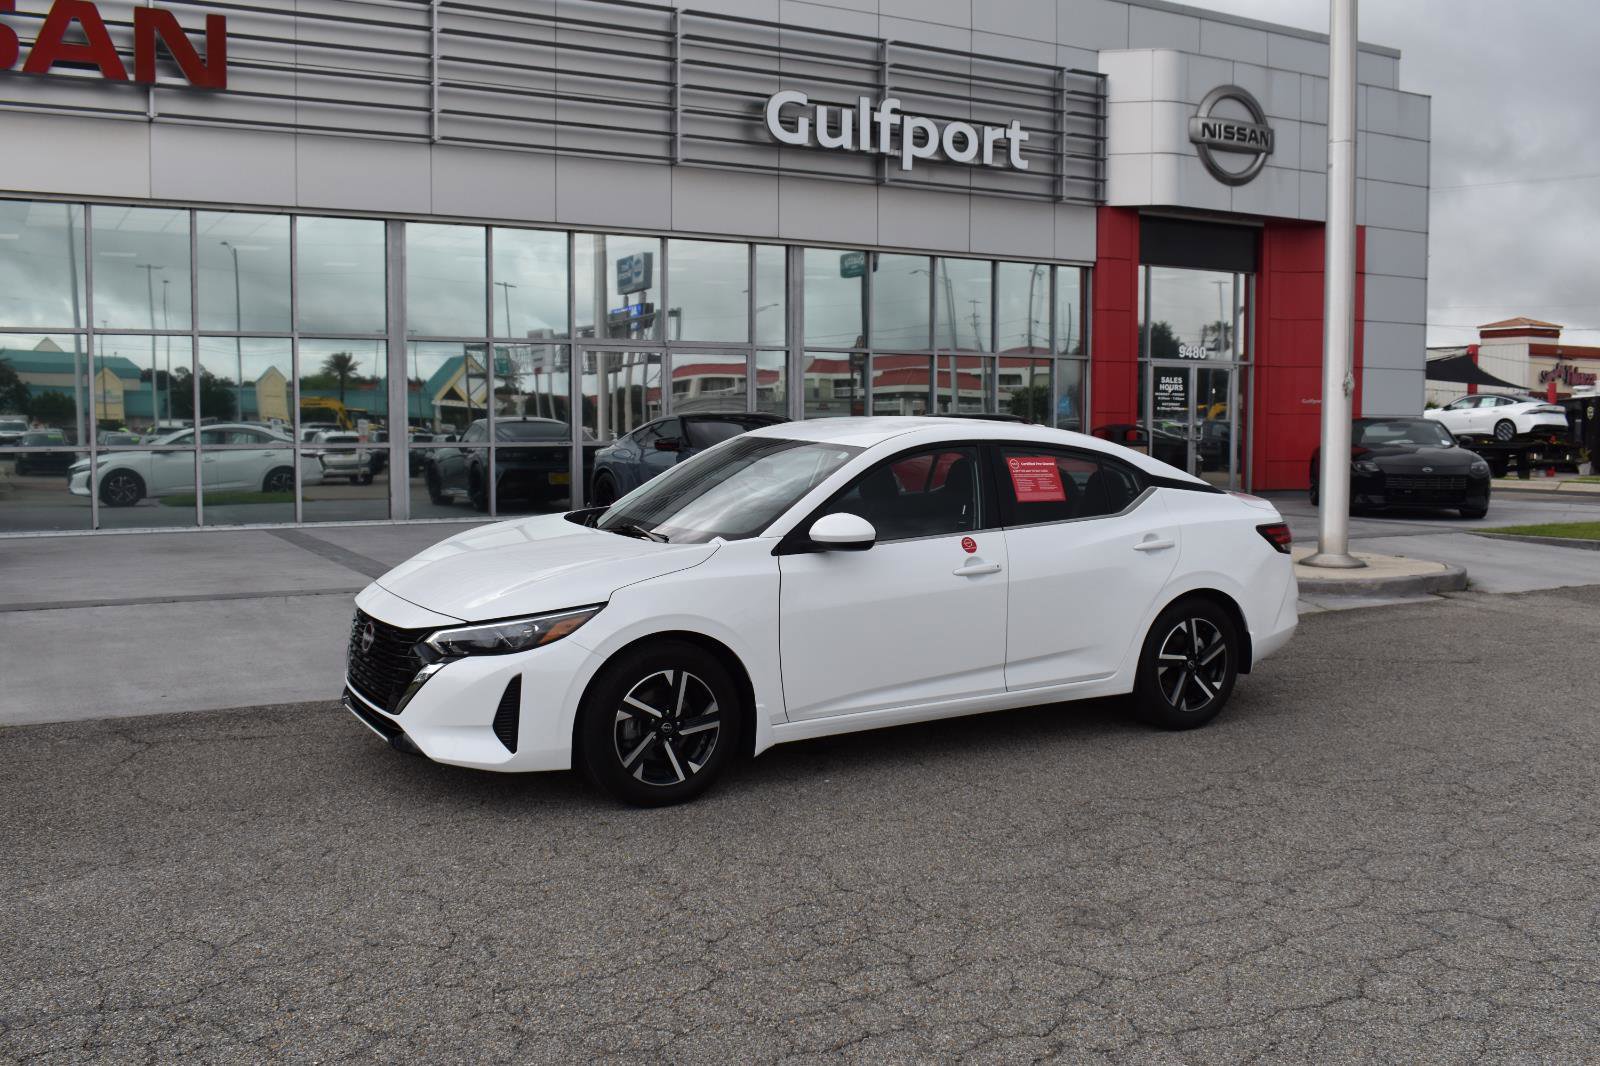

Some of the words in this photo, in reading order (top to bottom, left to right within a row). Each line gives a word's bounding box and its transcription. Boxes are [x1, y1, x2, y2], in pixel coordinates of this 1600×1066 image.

[0, 0, 227, 89] AN
[764, 89, 1030, 171] Gulfport
[1201, 121, 1271, 147] NISSAN
[1178, 344, 1206, 359] 9480
[1160, 376, 1183, 384] SALES
